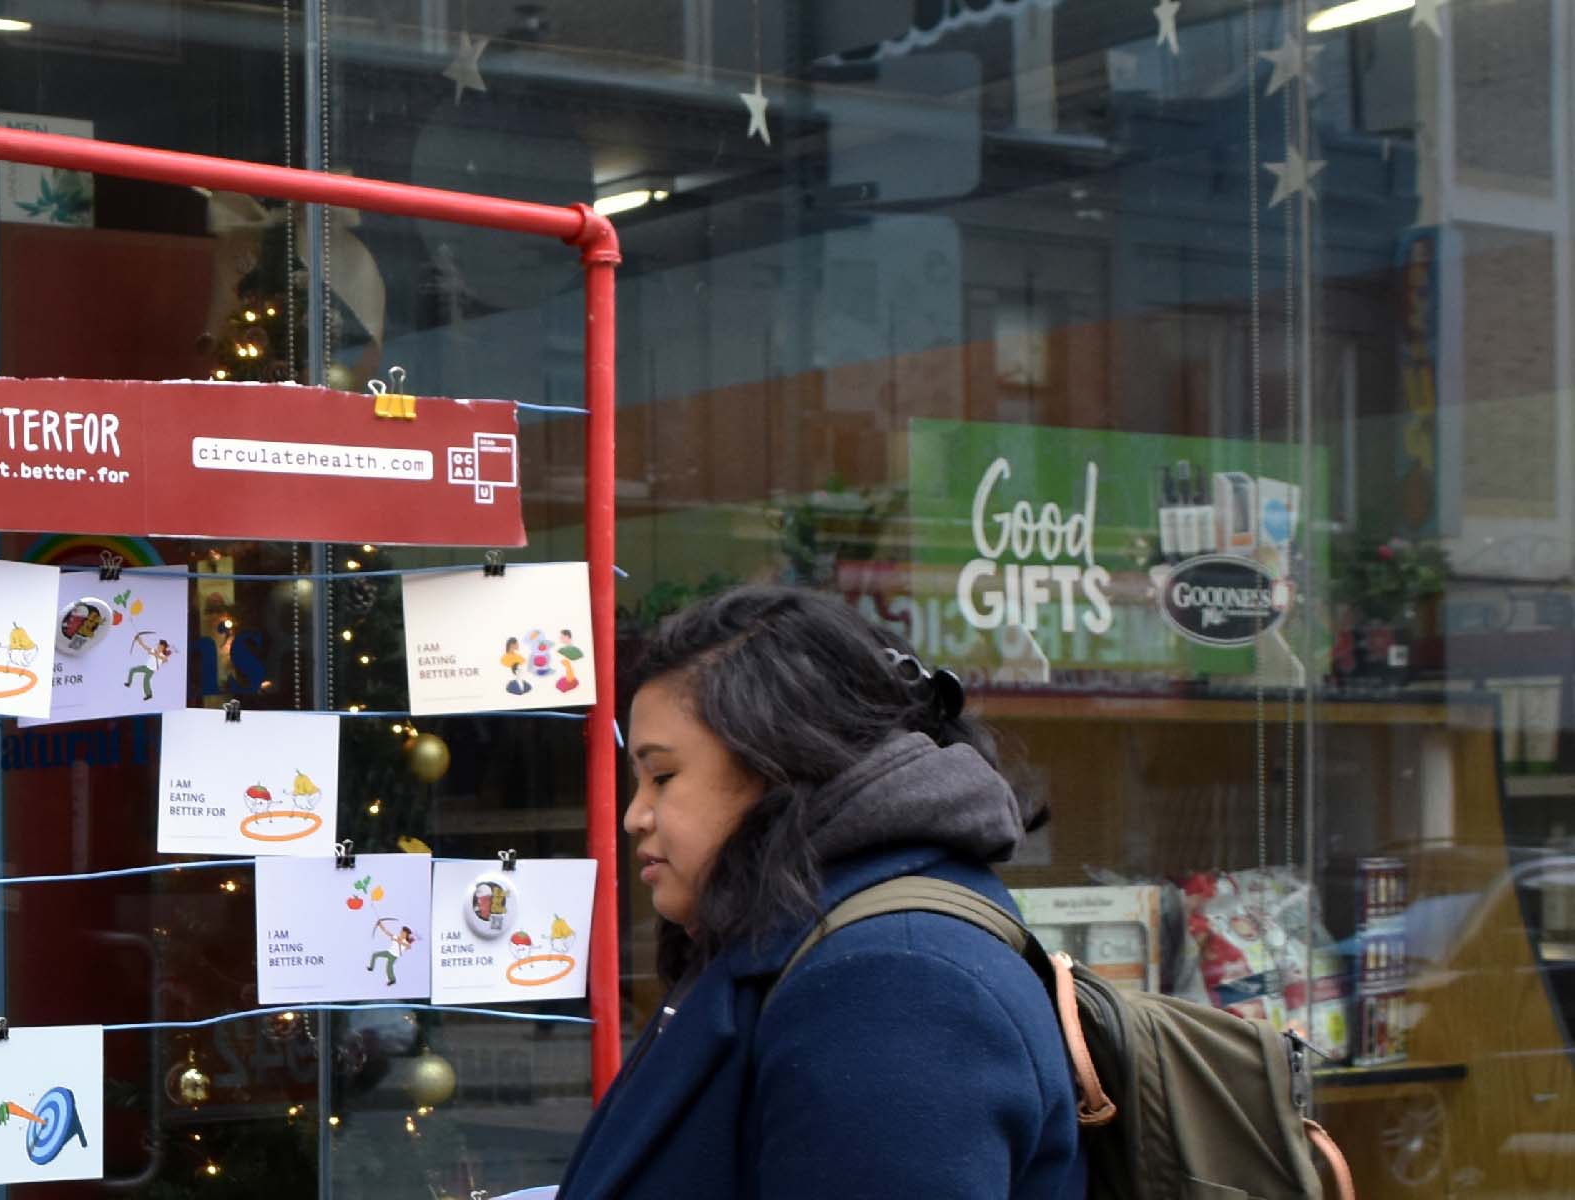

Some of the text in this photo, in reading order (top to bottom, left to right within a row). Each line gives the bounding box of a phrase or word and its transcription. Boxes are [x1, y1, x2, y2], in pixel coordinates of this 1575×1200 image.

[198, 446, 424, 472] circulatehealth.com
[480, 487, 488, 498] U
[972, 457, 1098, 566] Good
[957, 558, 1112, 632] GIFTS
